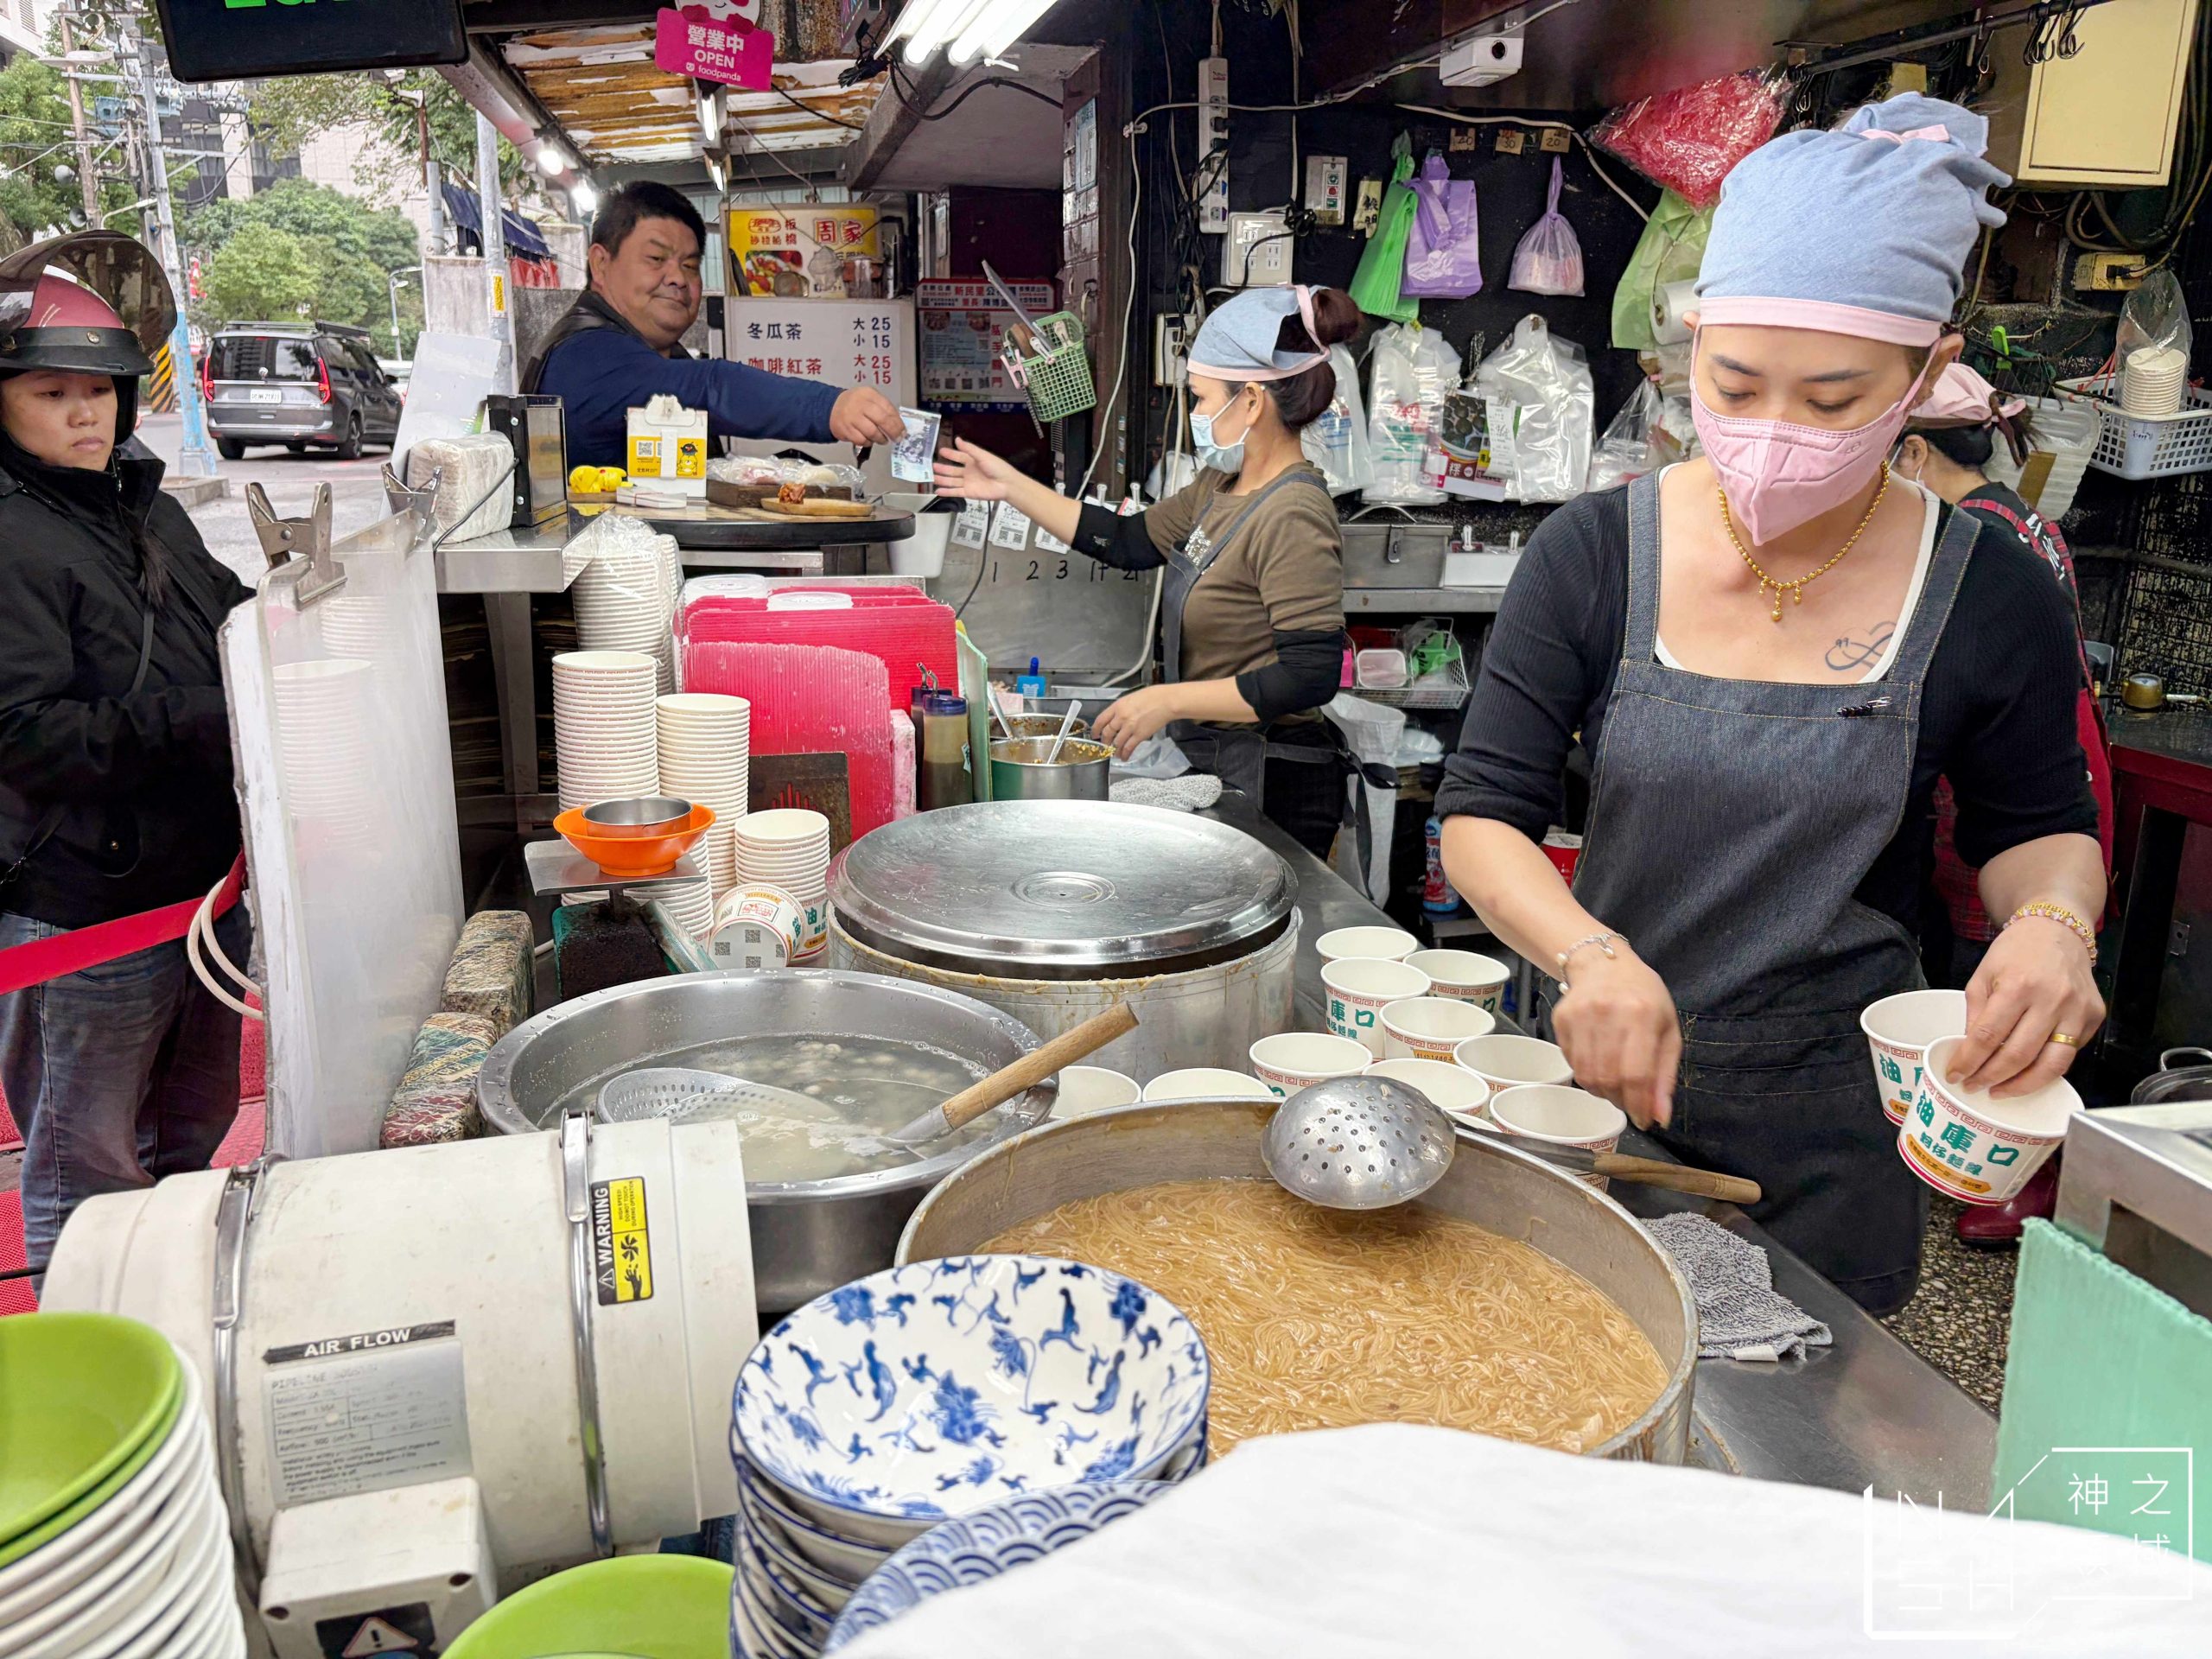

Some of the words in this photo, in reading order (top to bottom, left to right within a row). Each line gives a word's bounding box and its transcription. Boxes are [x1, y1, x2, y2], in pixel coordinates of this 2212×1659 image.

[687, 24, 745, 54] 營業中
[694, 49, 734, 68] OPEN
[698, 65, 741, 81] foodpanda
[816, 219, 864, 245] 周家
[747, 322, 803, 340] 冬瓜茶
[853, 318, 865, 331] 大
[871, 317, 891, 331] 25
[854, 334, 865, 346] 小
[873, 334, 890, 348] 15
[854, 354, 866, 367] 大
[871, 356, 891, 369] 25
[854, 371, 866, 383] 小
[874, 371, 891, 385] 15
[1027, 560, 1039, 582] 2
[1056, 560, 1069, 580] 3
[1331, 999, 1373, 1028] 庫口
[1916, 1090, 2019, 1166] 油庫口
[594, 1187, 613, 1267] WARNING
[304, 1340, 341, 1357] AIR
[350, 1328, 411, 1350] FLOW
